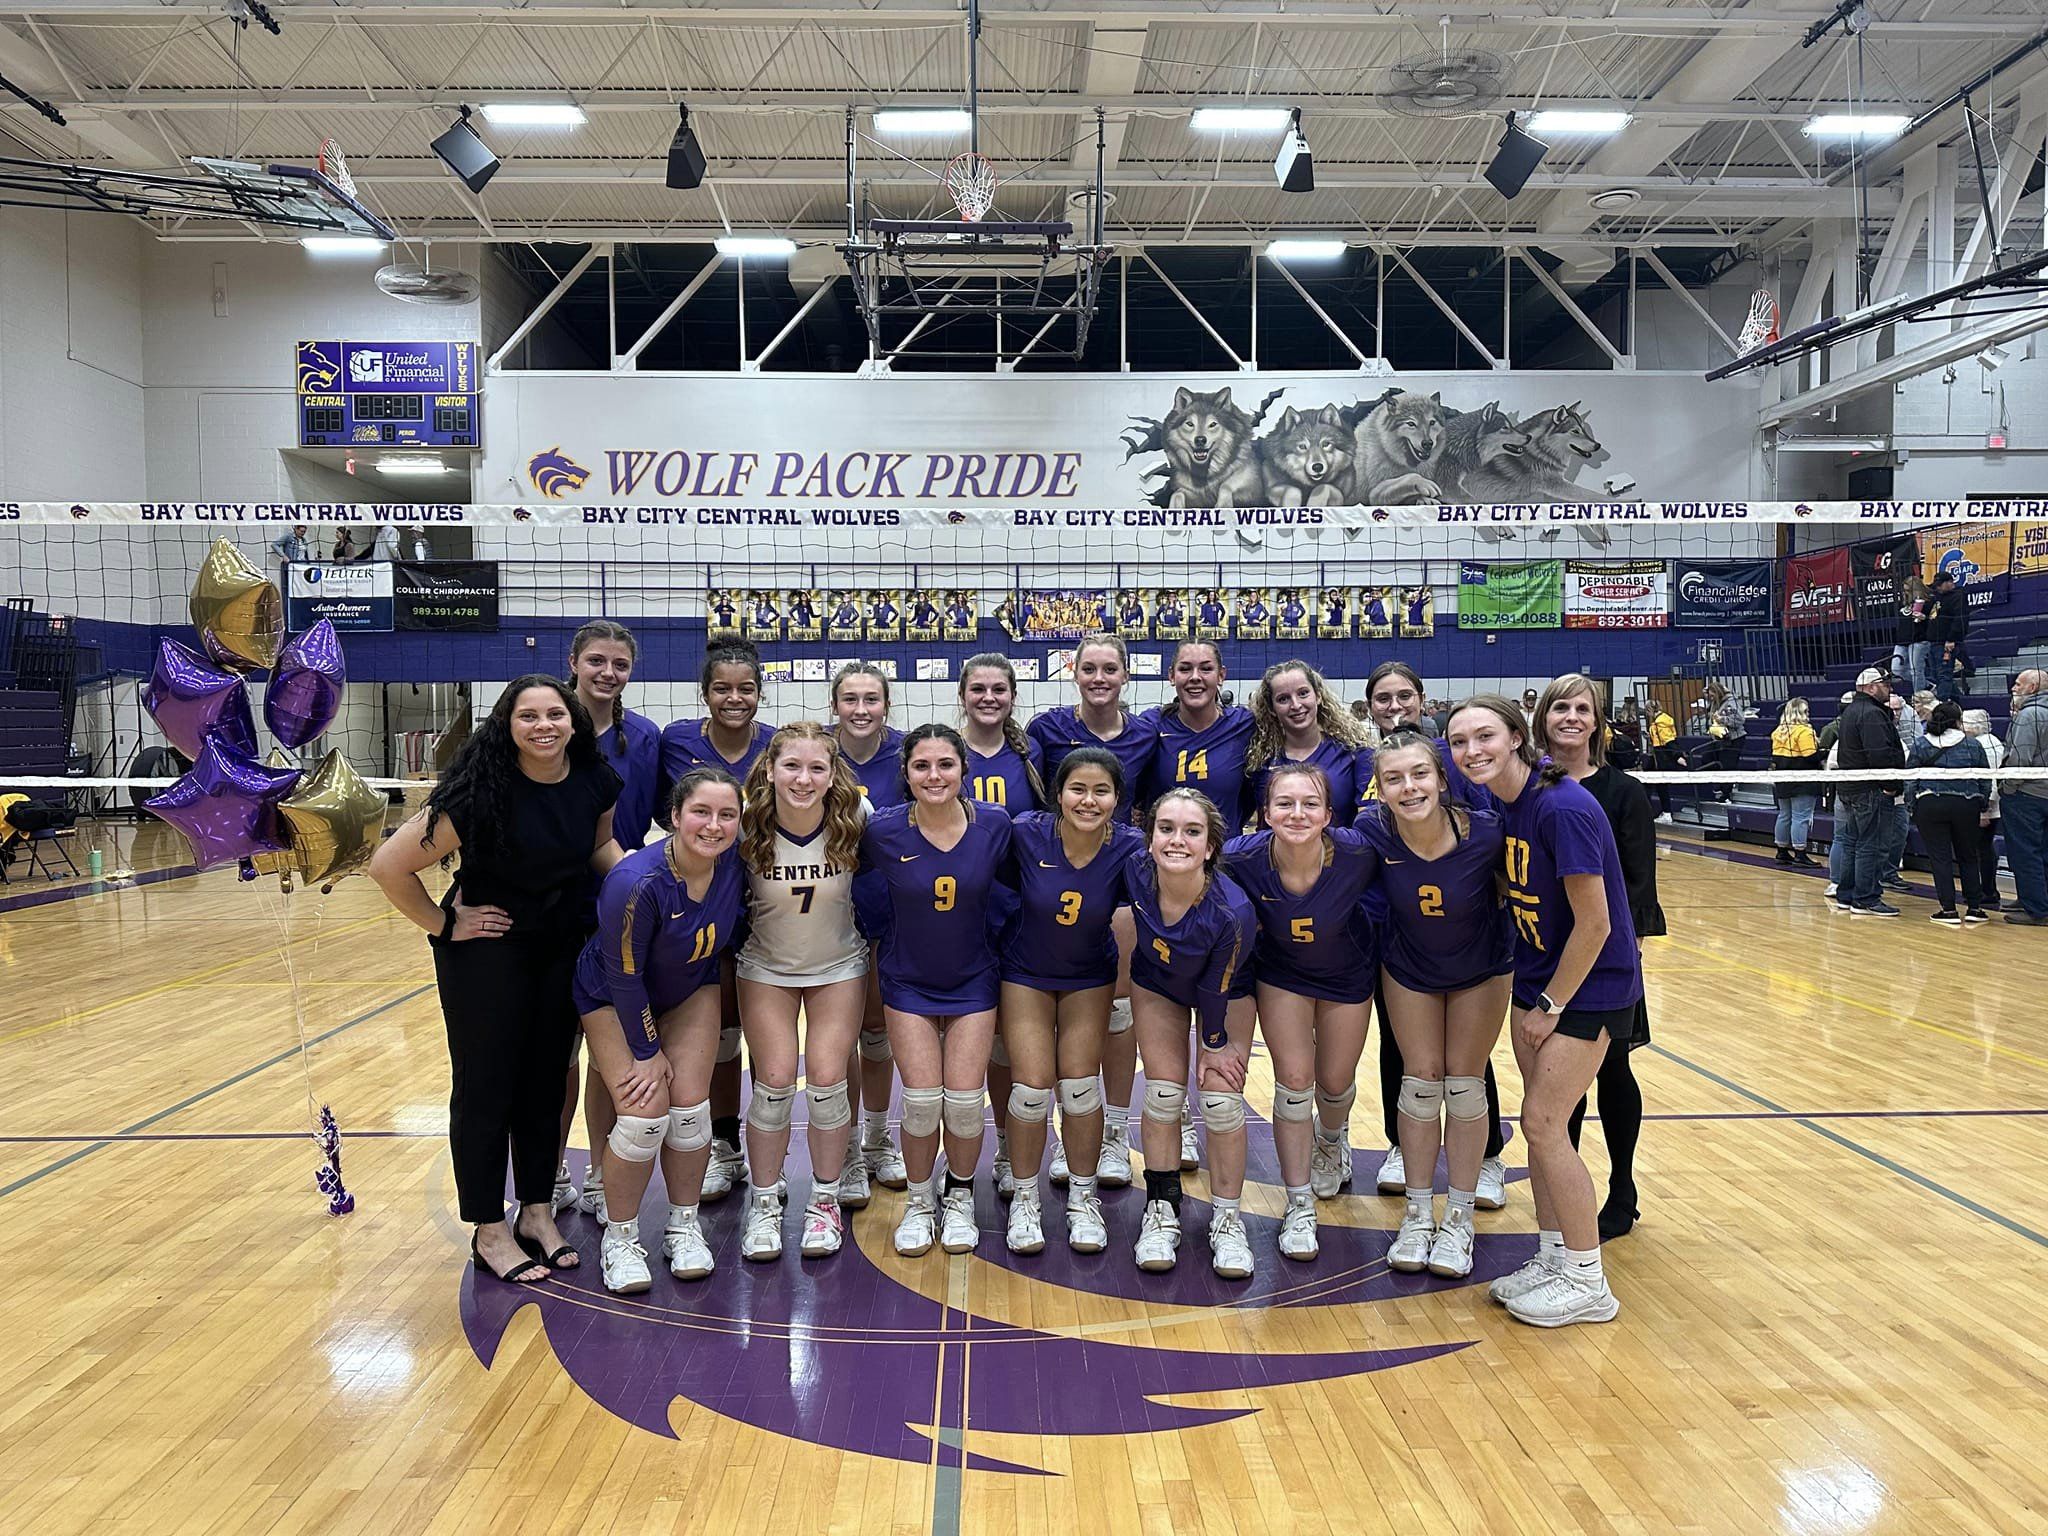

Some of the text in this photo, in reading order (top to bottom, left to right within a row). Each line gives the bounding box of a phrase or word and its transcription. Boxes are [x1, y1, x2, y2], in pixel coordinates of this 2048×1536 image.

[385, 353, 428, 365] United
[455, 344, 469, 391] WOLVES
[385, 365, 443, 377] Financial
[304, 396, 346, 407] CENTRAL
[435, 396, 467, 407] VISITOR
[604, 450, 1082, 498] WOLF PACK PRIDE
[140, 504, 464, 521] BAY CITY CENTRAL WOLVES
[582, 507, 900, 526] BAY CITY CENTRAL WOLVES
[1013, 508, 1323, 526] BAY CITY CENTRAL WOLVES
[1437, 503, 1748, 521] BAY CITY CENTRAL WOLVES
[1859, 502, 1904, 518] BAY
[1911, 501, 1960, 518] CITY
[2025, 526, 2048, 543] VISI
[1579, 576, 1654, 588] DEPENDABLE
[396, 586, 496, 596] COLLIER CHIROPRACTIC
[1590, 588, 1615, 597] SEWER
[1688, 585, 1767, 598] FinancialEdge
[311, 603, 371, 612] Auto-Owners
[412, 606, 480, 616] 989.391.4788
[1461, 612, 1558, 625] 989-791-0088
[1177, 749, 1208, 782] 14
[974, 776, 1006, 807] 10
[763, 863, 842, 881] CENTRAL
[791, 885, 816, 915] 7
[934, 876, 956, 912] 9
[1418, 884, 1446, 917] 2
[1055, 891, 1083, 926] 3
[1290, 917, 1315, 943] 5
[686, 923, 716, 965] 11
